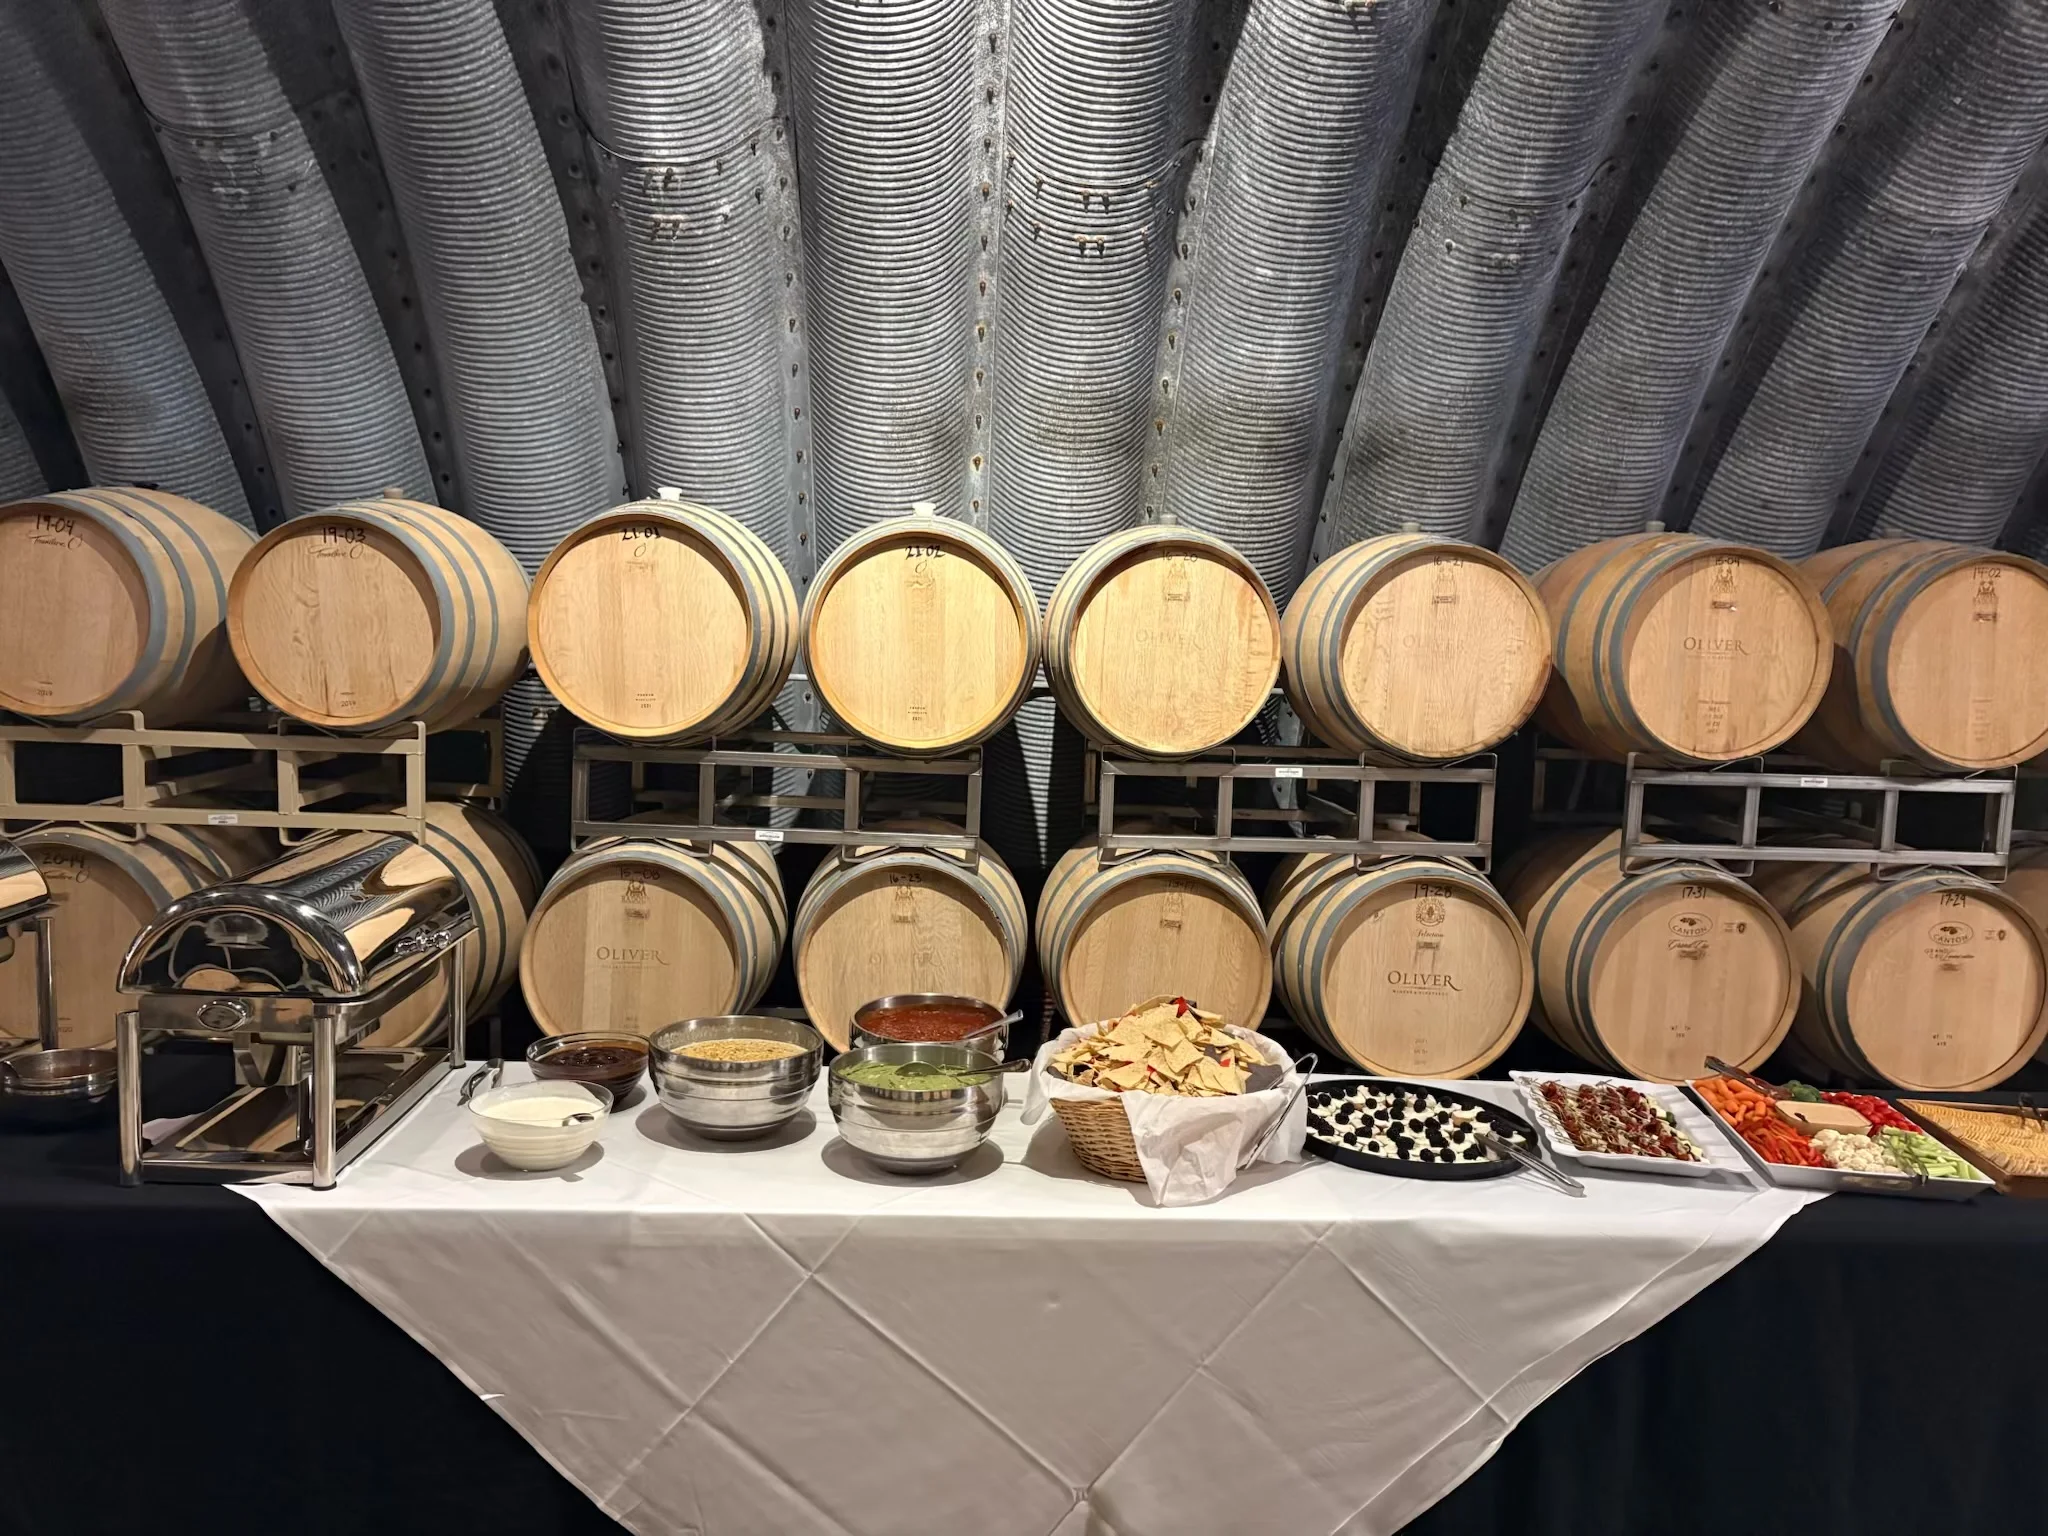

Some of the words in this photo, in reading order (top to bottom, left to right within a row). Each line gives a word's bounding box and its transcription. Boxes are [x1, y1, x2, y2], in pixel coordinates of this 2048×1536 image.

[35, 513, 76, 537] 19-04
[322, 526, 366, 545] 19-03
[1683, 636, 1751, 657] OLIVER
[1682, 886, 1706, 900] 17-31
[1671, 924, 1708, 937] CANTON
[1932, 933, 1969, 945] CANTON
[596, 946, 673, 966] OLIVER
[1387, 970, 1463, 991] OLIVER
